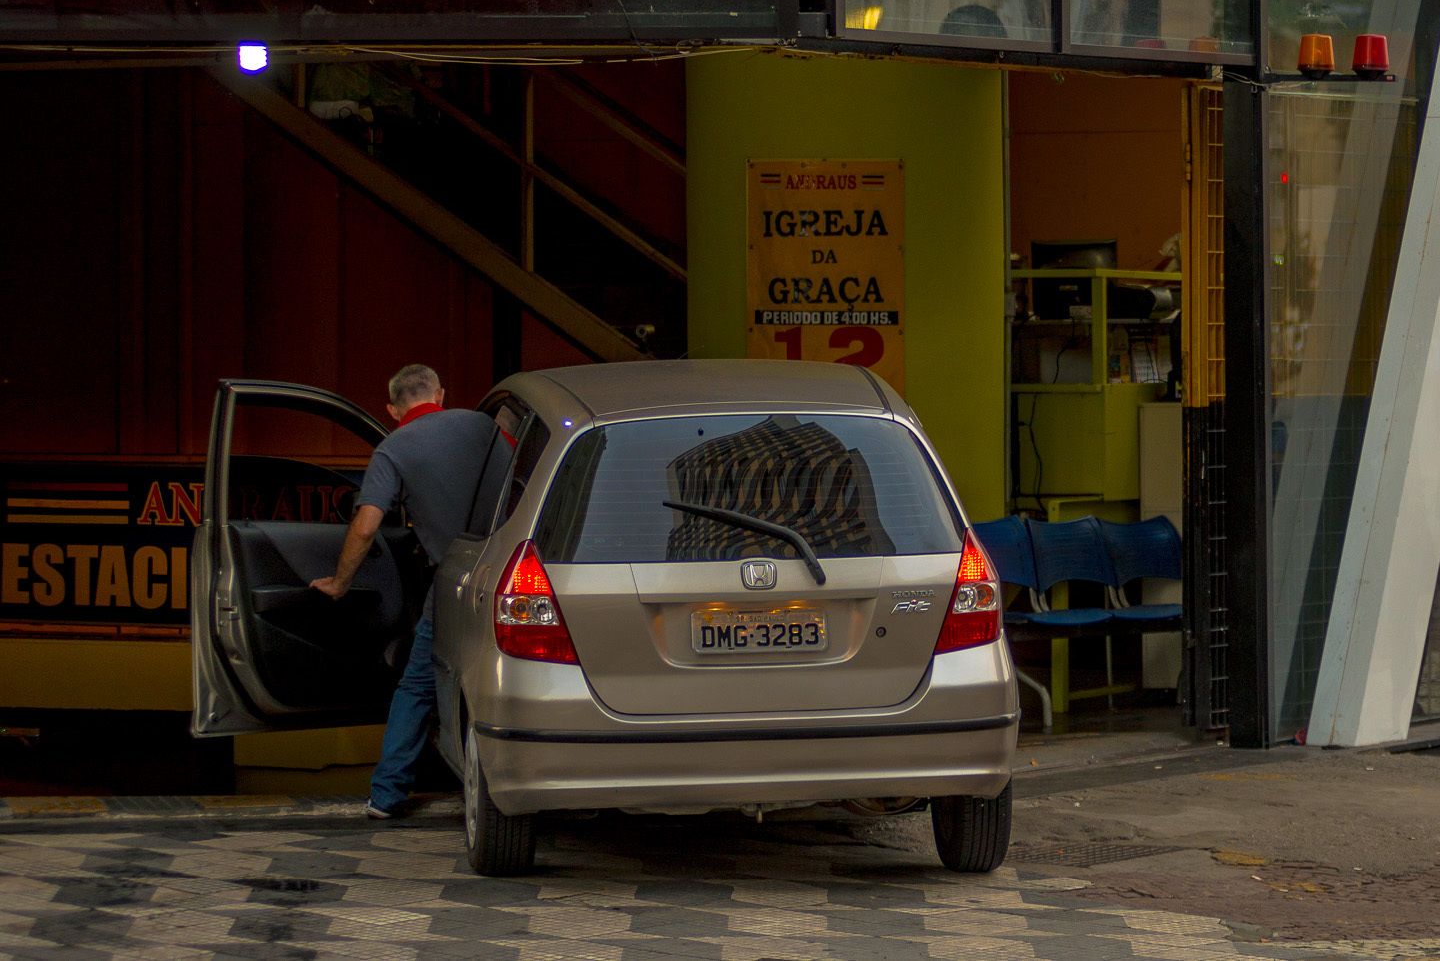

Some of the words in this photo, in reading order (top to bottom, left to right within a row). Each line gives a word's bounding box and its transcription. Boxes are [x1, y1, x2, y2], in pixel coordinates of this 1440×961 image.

[763, 210, 888, 237] IGREJA
[811, 249, 838, 264] DA
[768, 276, 884, 312] GRAÇA
[763, 311, 821, 325] PERIODO
[823, 311, 839, 324] DE
